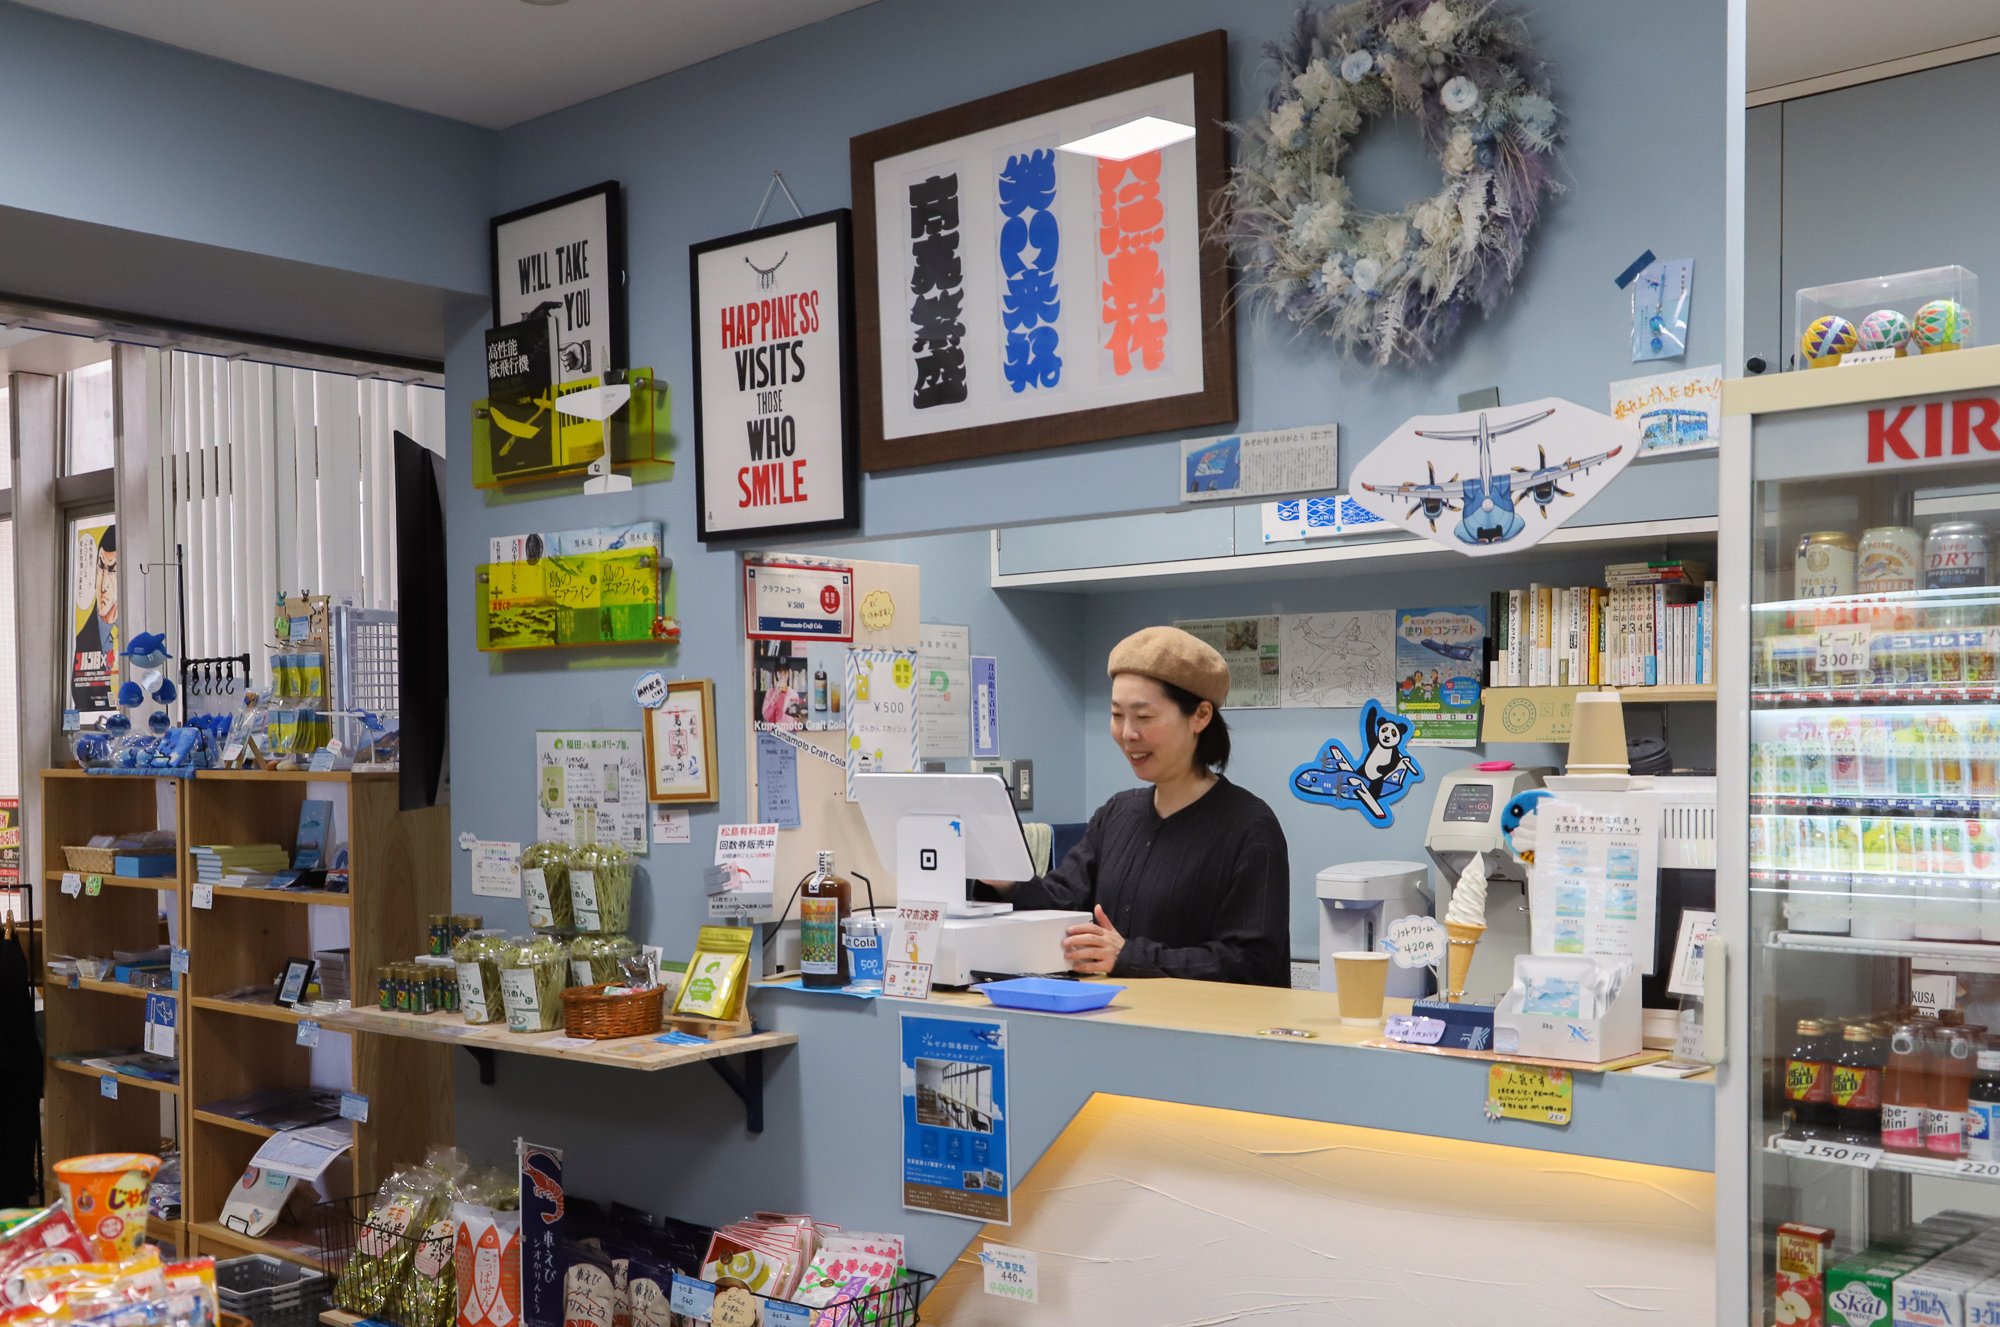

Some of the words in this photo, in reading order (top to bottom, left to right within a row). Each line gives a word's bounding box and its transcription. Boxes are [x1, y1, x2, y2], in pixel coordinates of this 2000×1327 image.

[555, 239, 589, 286] TAKE
[563, 288, 591, 331] YOU
[720, 289, 820, 350] HAPPINESS
[487, 338, 518, 360] 高性能
[488, 355, 530, 379] 紙飛行機
[734, 340, 806, 391] VISITS
[756, 389, 783, 416] THOSE
[746, 414, 796, 461] WHO
[552, 584, 595, 602] エアライン
[604, 577, 645, 596] エアライン
[762, 584, 802, 594] クラフトコーラ
[1404, 624, 1477, 637] 塗り絵コンテスト
[1818, 632, 1867, 648] ビール
[1891, 633, 1976, 647] コールド
[1819, 653, 1864, 667] 300円
[874, 702, 904, 714] ¥500
[754, 720, 803, 732] Kumamoto
[805, 719, 827, 731] Craft
[828, 719, 846, 730] Cola
[771, 727, 809, 752] Kumamoto
[810, 745, 829, 759] Craft
[829, 753, 846, 768] Cola
[720, 825, 777, 838] 松島有料道路
[719, 839, 776, 851] 回数券販売中
[898, 908, 940, 922] スマホ決済
[853, 938, 876, 948] Cola
[1404, 941, 1434, 954] 420円
[860, 958, 879, 970] 500
[1414, 1000, 1450, 1009] AMAKUSA
[1789, 1065, 1811, 1077] REAL
[1834, 1071, 1855, 1083] REAL
[1508, 1073, 1545, 1087] 人気です
[1789, 1075, 1814, 1087] GOLD
[1833, 1081, 1858, 1092] GOLD
[1804, 1145, 1871, 1162] 150円
[1961, 1162, 2000, 1175] 220
[1789, 1239, 1810, 1248] Apple
[1785, 1247, 1815, 1265] 100%
[575, 1267, 602, 1286] 車えび
